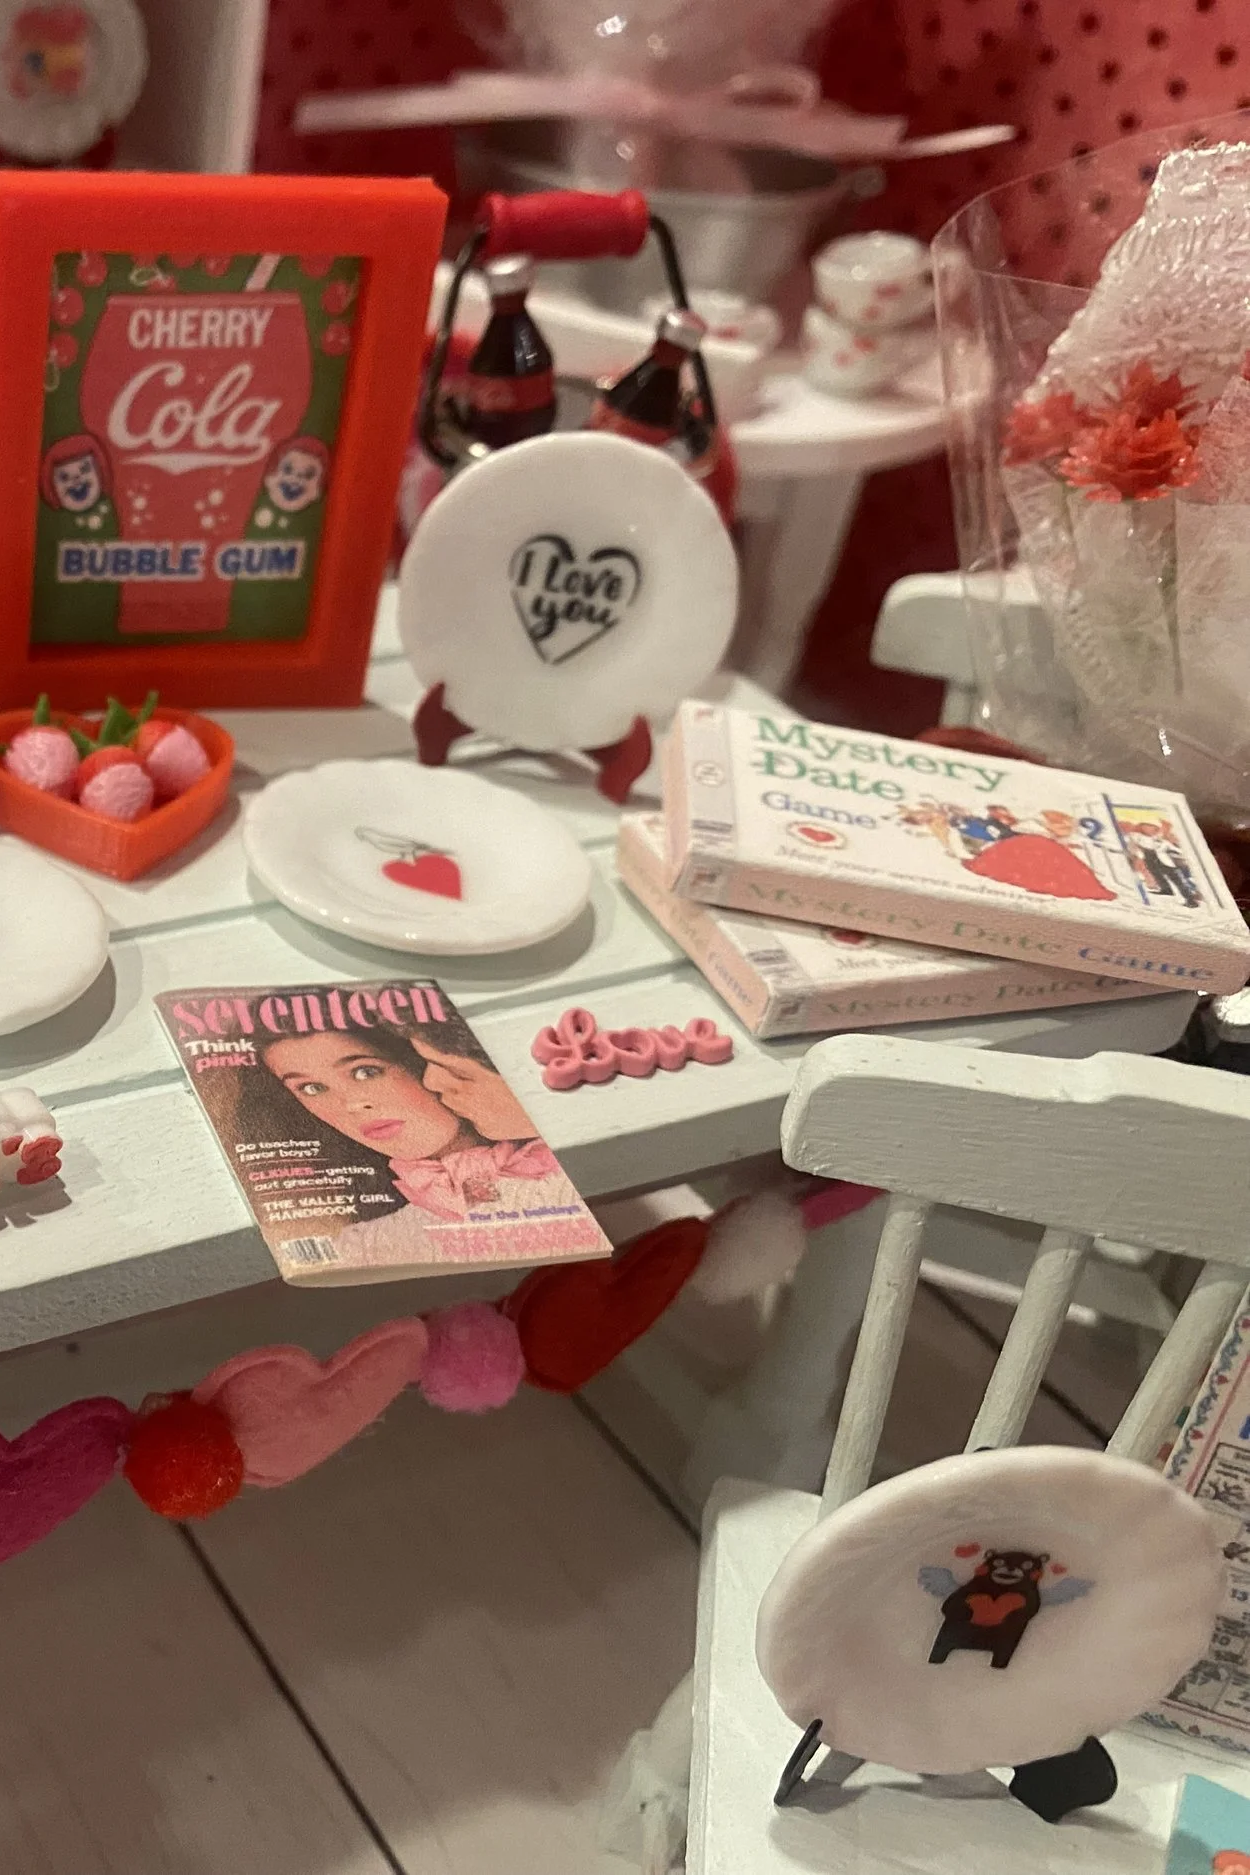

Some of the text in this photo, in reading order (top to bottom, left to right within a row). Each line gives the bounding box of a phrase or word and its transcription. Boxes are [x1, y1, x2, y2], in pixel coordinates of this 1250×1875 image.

[128, 308, 273, 350] CHERRY
[107, 361, 282, 473] Cola
[61, 545, 299, 577] BUBBLE GUM
[516, 549, 535, 587] I
[529, 594, 611, 642] you
[753, 716, 1010, 793] Mystery
[751, 750, 905, 801] Date
[761, 790, 878, 830] Game
[172, 987, 448, 1040] seventeen
[184, 1038, 257, 1055] Think
[195, 1052, 257, 1073] pink!
[259, 1139, 321, 1149] teachers
[279, 1148, 320, 1159] boys?
[263, 1193, 395, 1212] THE VALLEY GIRL
[268, 1204, 358, 1222] HANDBOOK
